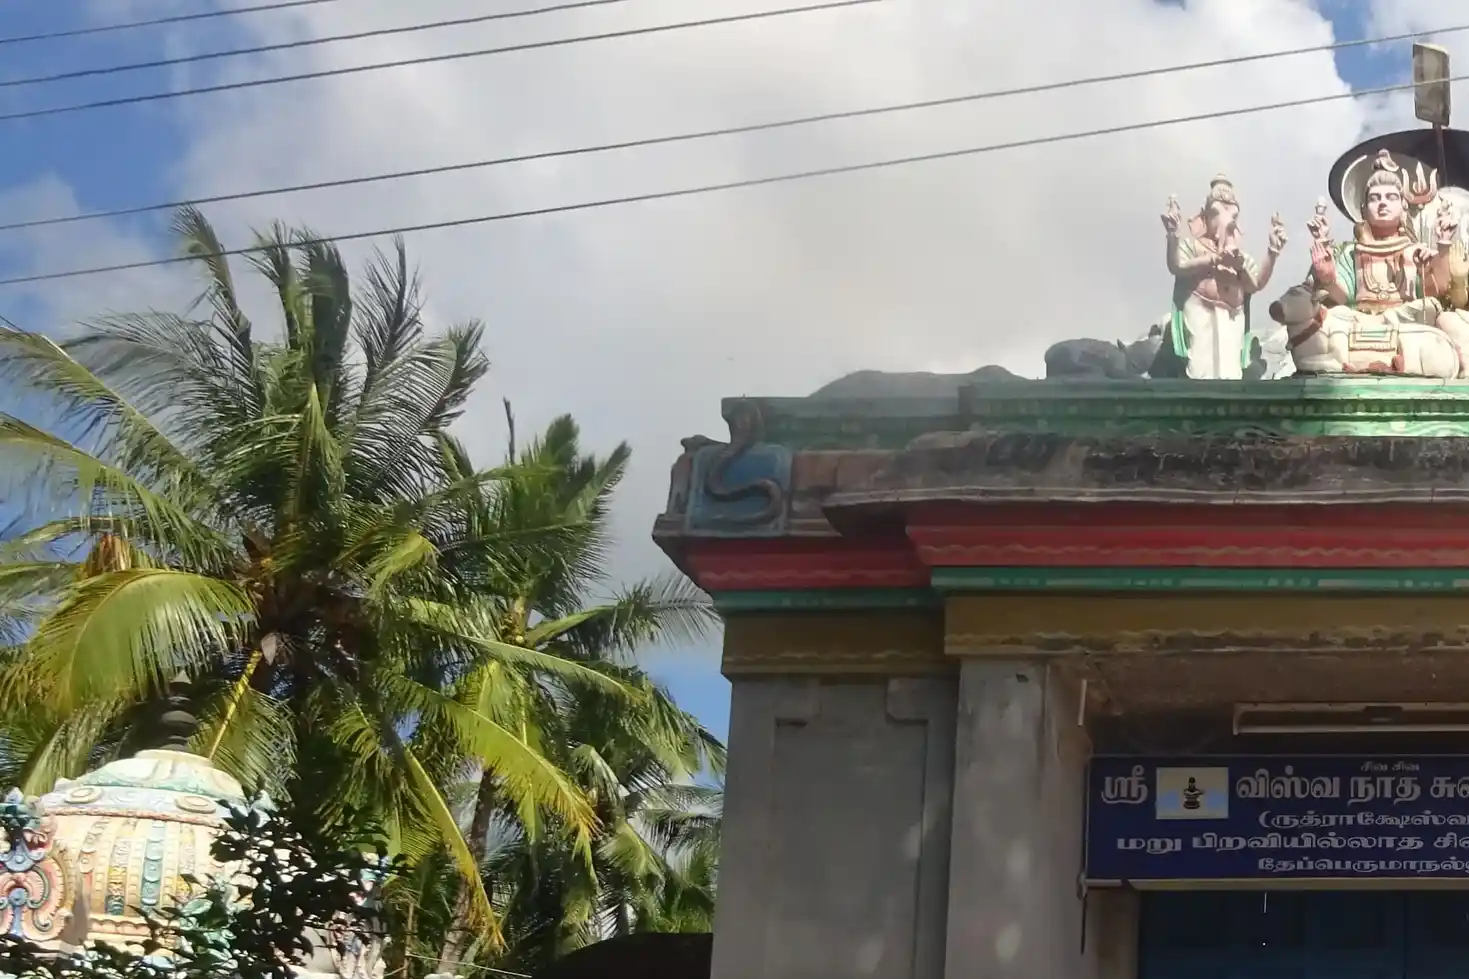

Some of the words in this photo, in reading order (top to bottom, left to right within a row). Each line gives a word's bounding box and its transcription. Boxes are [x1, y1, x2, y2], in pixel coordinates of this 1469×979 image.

[1236, 766, 1340, 800] விஸ்வ
[1347, 773, 1422, 805] நாத
[1117, 836, 1182, 855] மறு
[1192, 831, 1425, 853] பிறவியில்லாத
